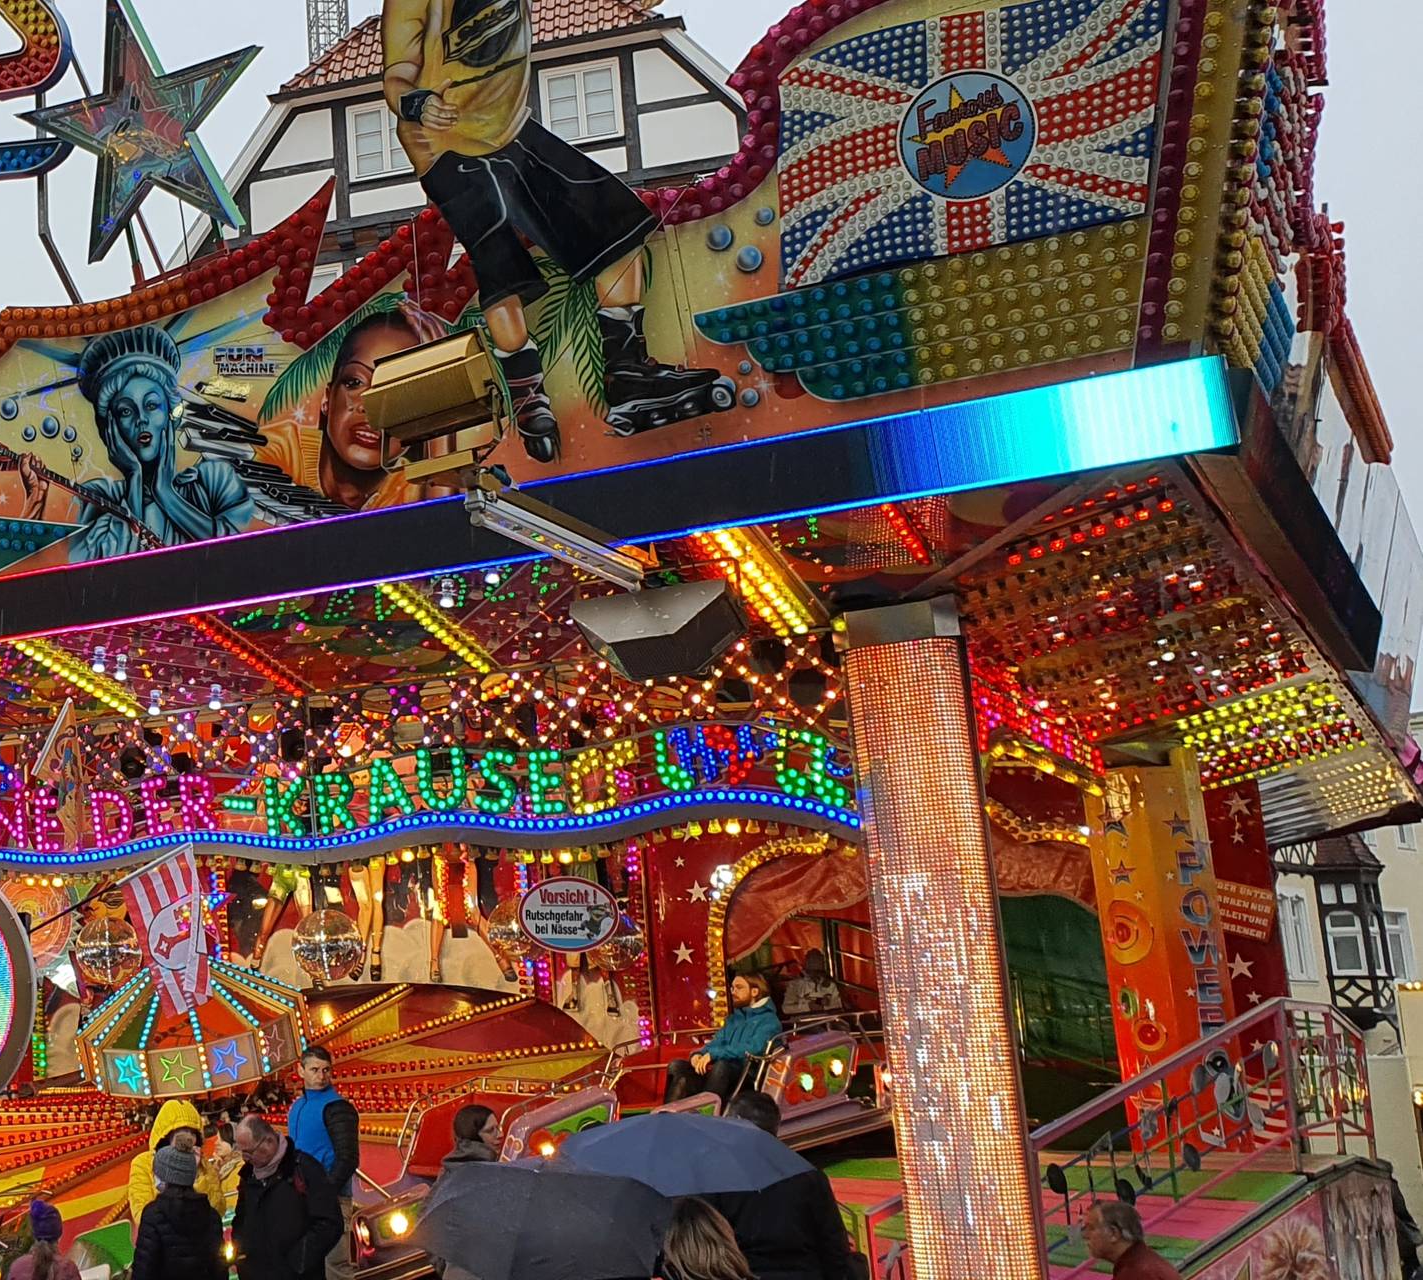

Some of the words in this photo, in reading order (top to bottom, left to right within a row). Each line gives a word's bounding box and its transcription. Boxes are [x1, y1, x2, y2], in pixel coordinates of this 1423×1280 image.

[916, 82, 1005, 141] Famous
[916, 103, 1025, 182] MUSIC
[214, 347, 264, 363] FUN
[218, 362, 275, 375] MACHINE
[539, 888, 590, 905] Vorsicht
[525, 909, 584, 924] Rutschgefahr
[535, 923, 549, 935] bei
[551, 923, 578, 936] Nässe
